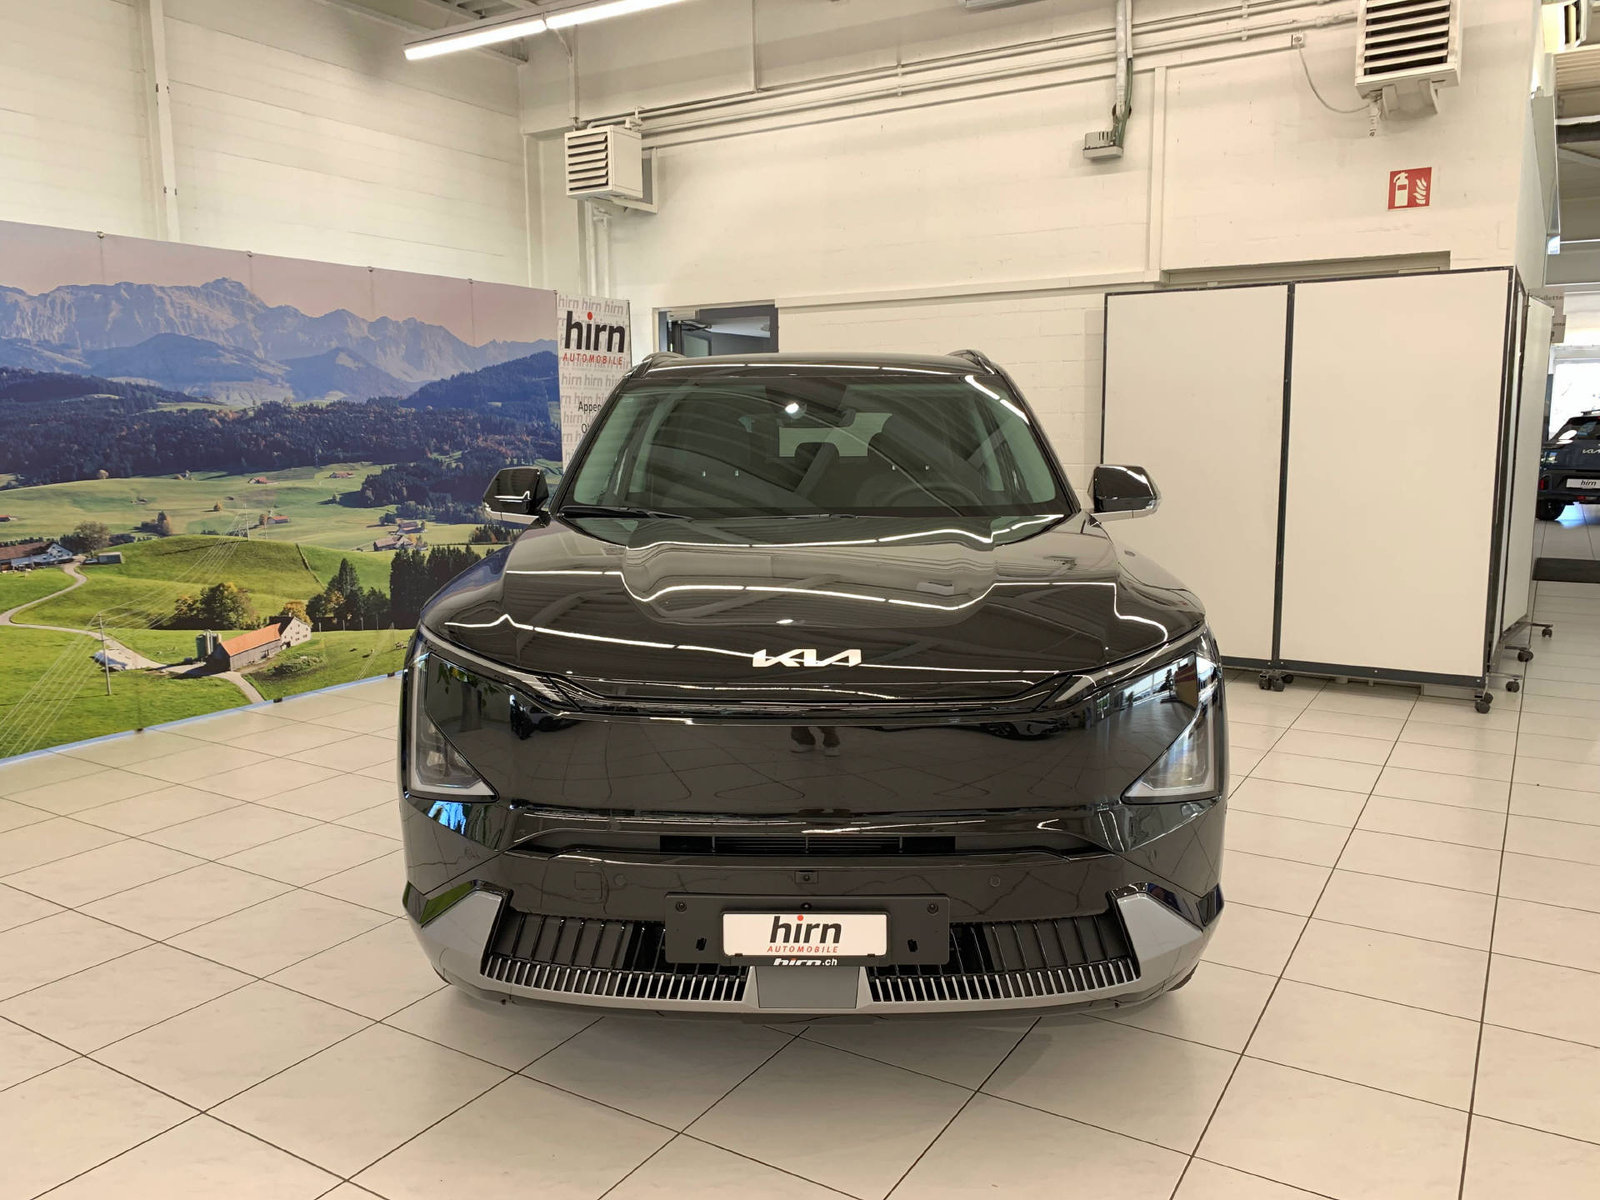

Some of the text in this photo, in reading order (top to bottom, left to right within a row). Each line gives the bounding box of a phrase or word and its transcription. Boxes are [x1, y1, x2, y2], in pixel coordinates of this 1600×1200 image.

[565, 310, 626, 353] hirn
[562, 352, 623, 366] AUTOMOBILE
[752, 649, 861, 667] KIA
[770, 915, 842, 943] hirn
[773, 957, 838, 966] hirn.ch
